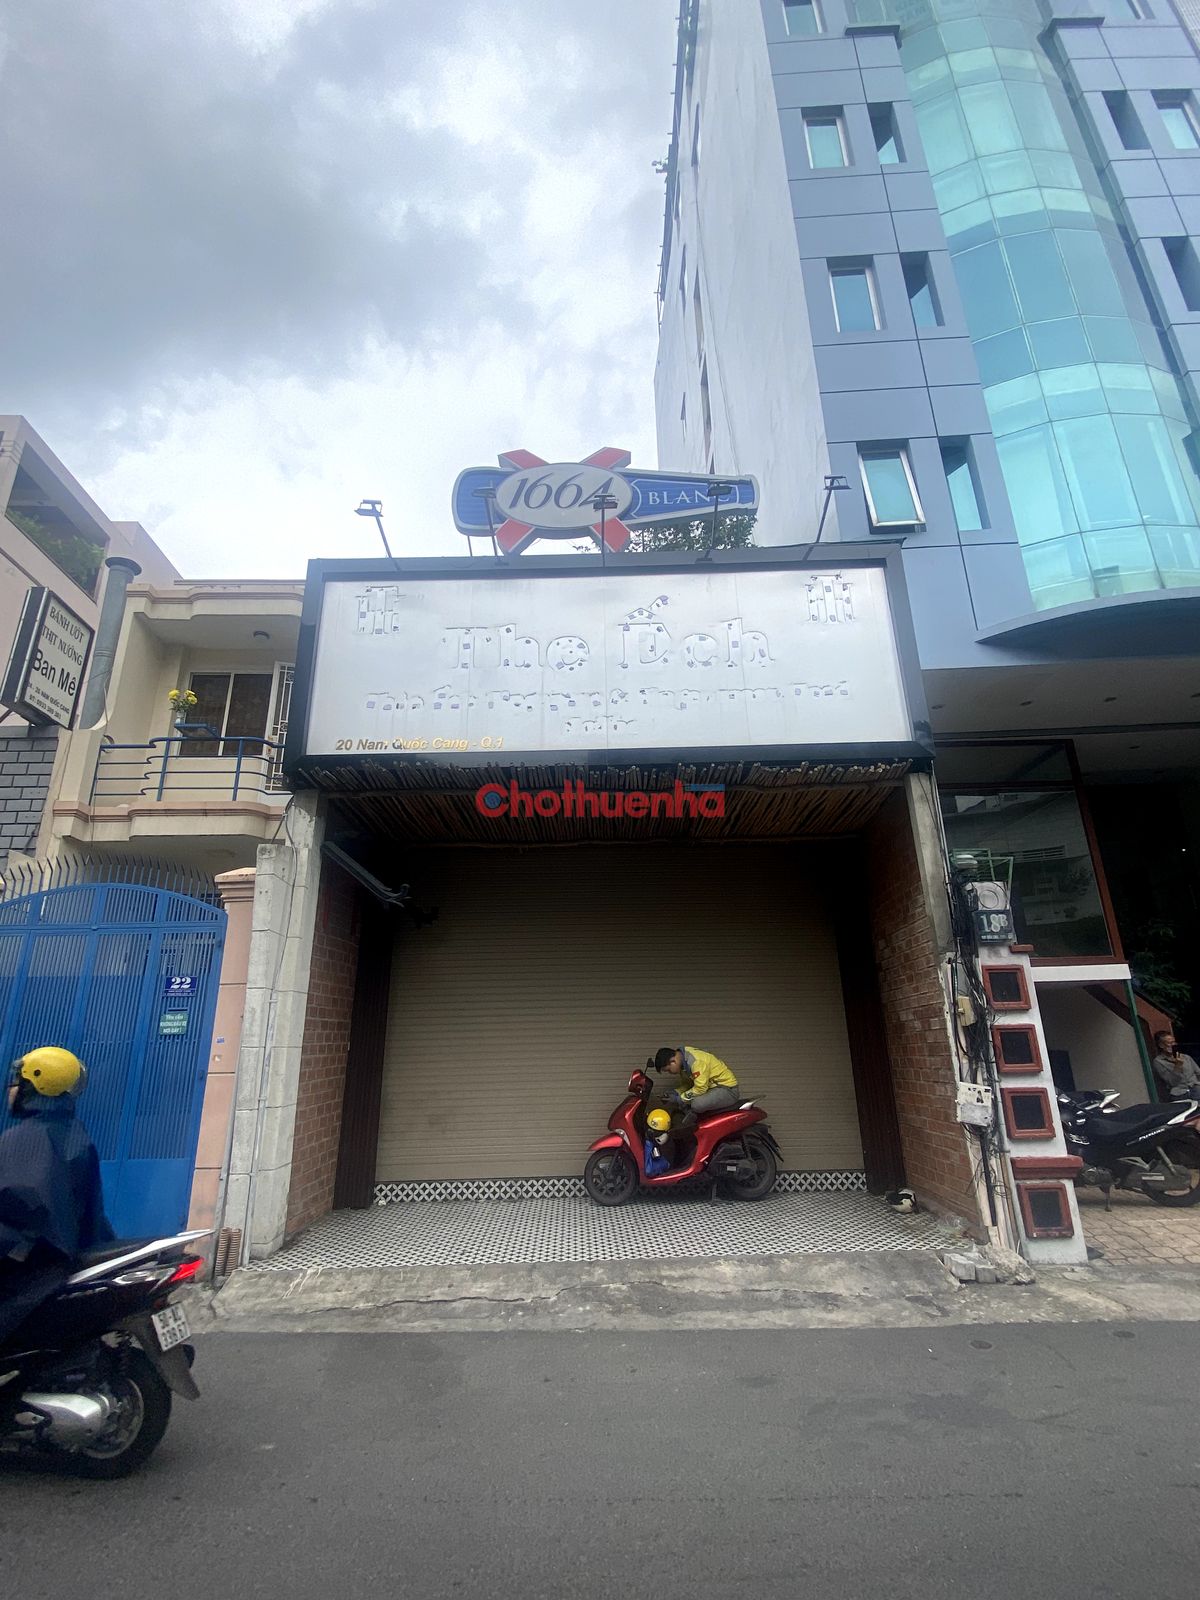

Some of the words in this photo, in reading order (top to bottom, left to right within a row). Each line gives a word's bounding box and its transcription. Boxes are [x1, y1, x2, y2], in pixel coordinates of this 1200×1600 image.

[508, 471, 614, 509] 1664
[50, 605, 71, 631] BÁNH
[42, 625, 59, 645] THỊT
[58, 638, 83, 666] NƯỚNG
[33, 649, 55, 684] Ban
[57, 667, 76, 696] Mê
[335, 739, 352, 751] 20
[980, 914, 1008, 932] 18B
[170, 976, 192, 989] 22
